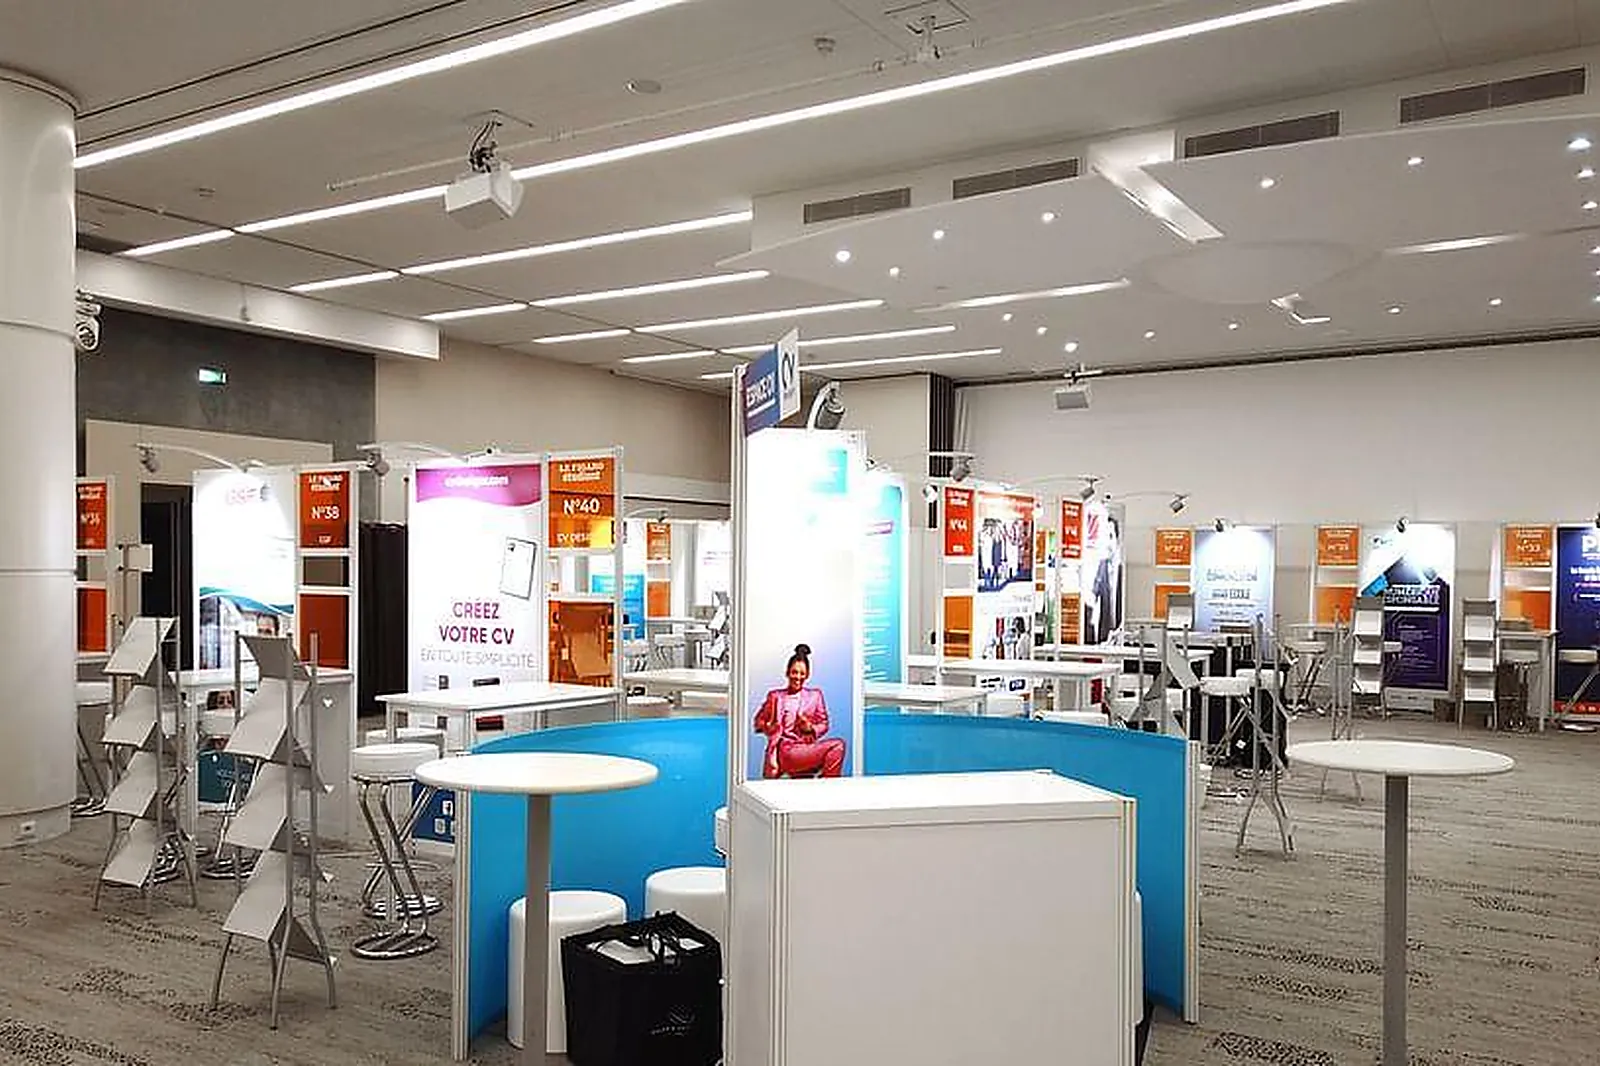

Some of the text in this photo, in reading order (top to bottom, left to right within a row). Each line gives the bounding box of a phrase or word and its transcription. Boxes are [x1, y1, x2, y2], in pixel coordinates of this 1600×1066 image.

[311, 505, 340, 519] N°38
[563, 497, 600, 515] N°40
[452, 597, 501, 619] CRÉEZ
[438, 625, 515, 645] VOTRE CV
